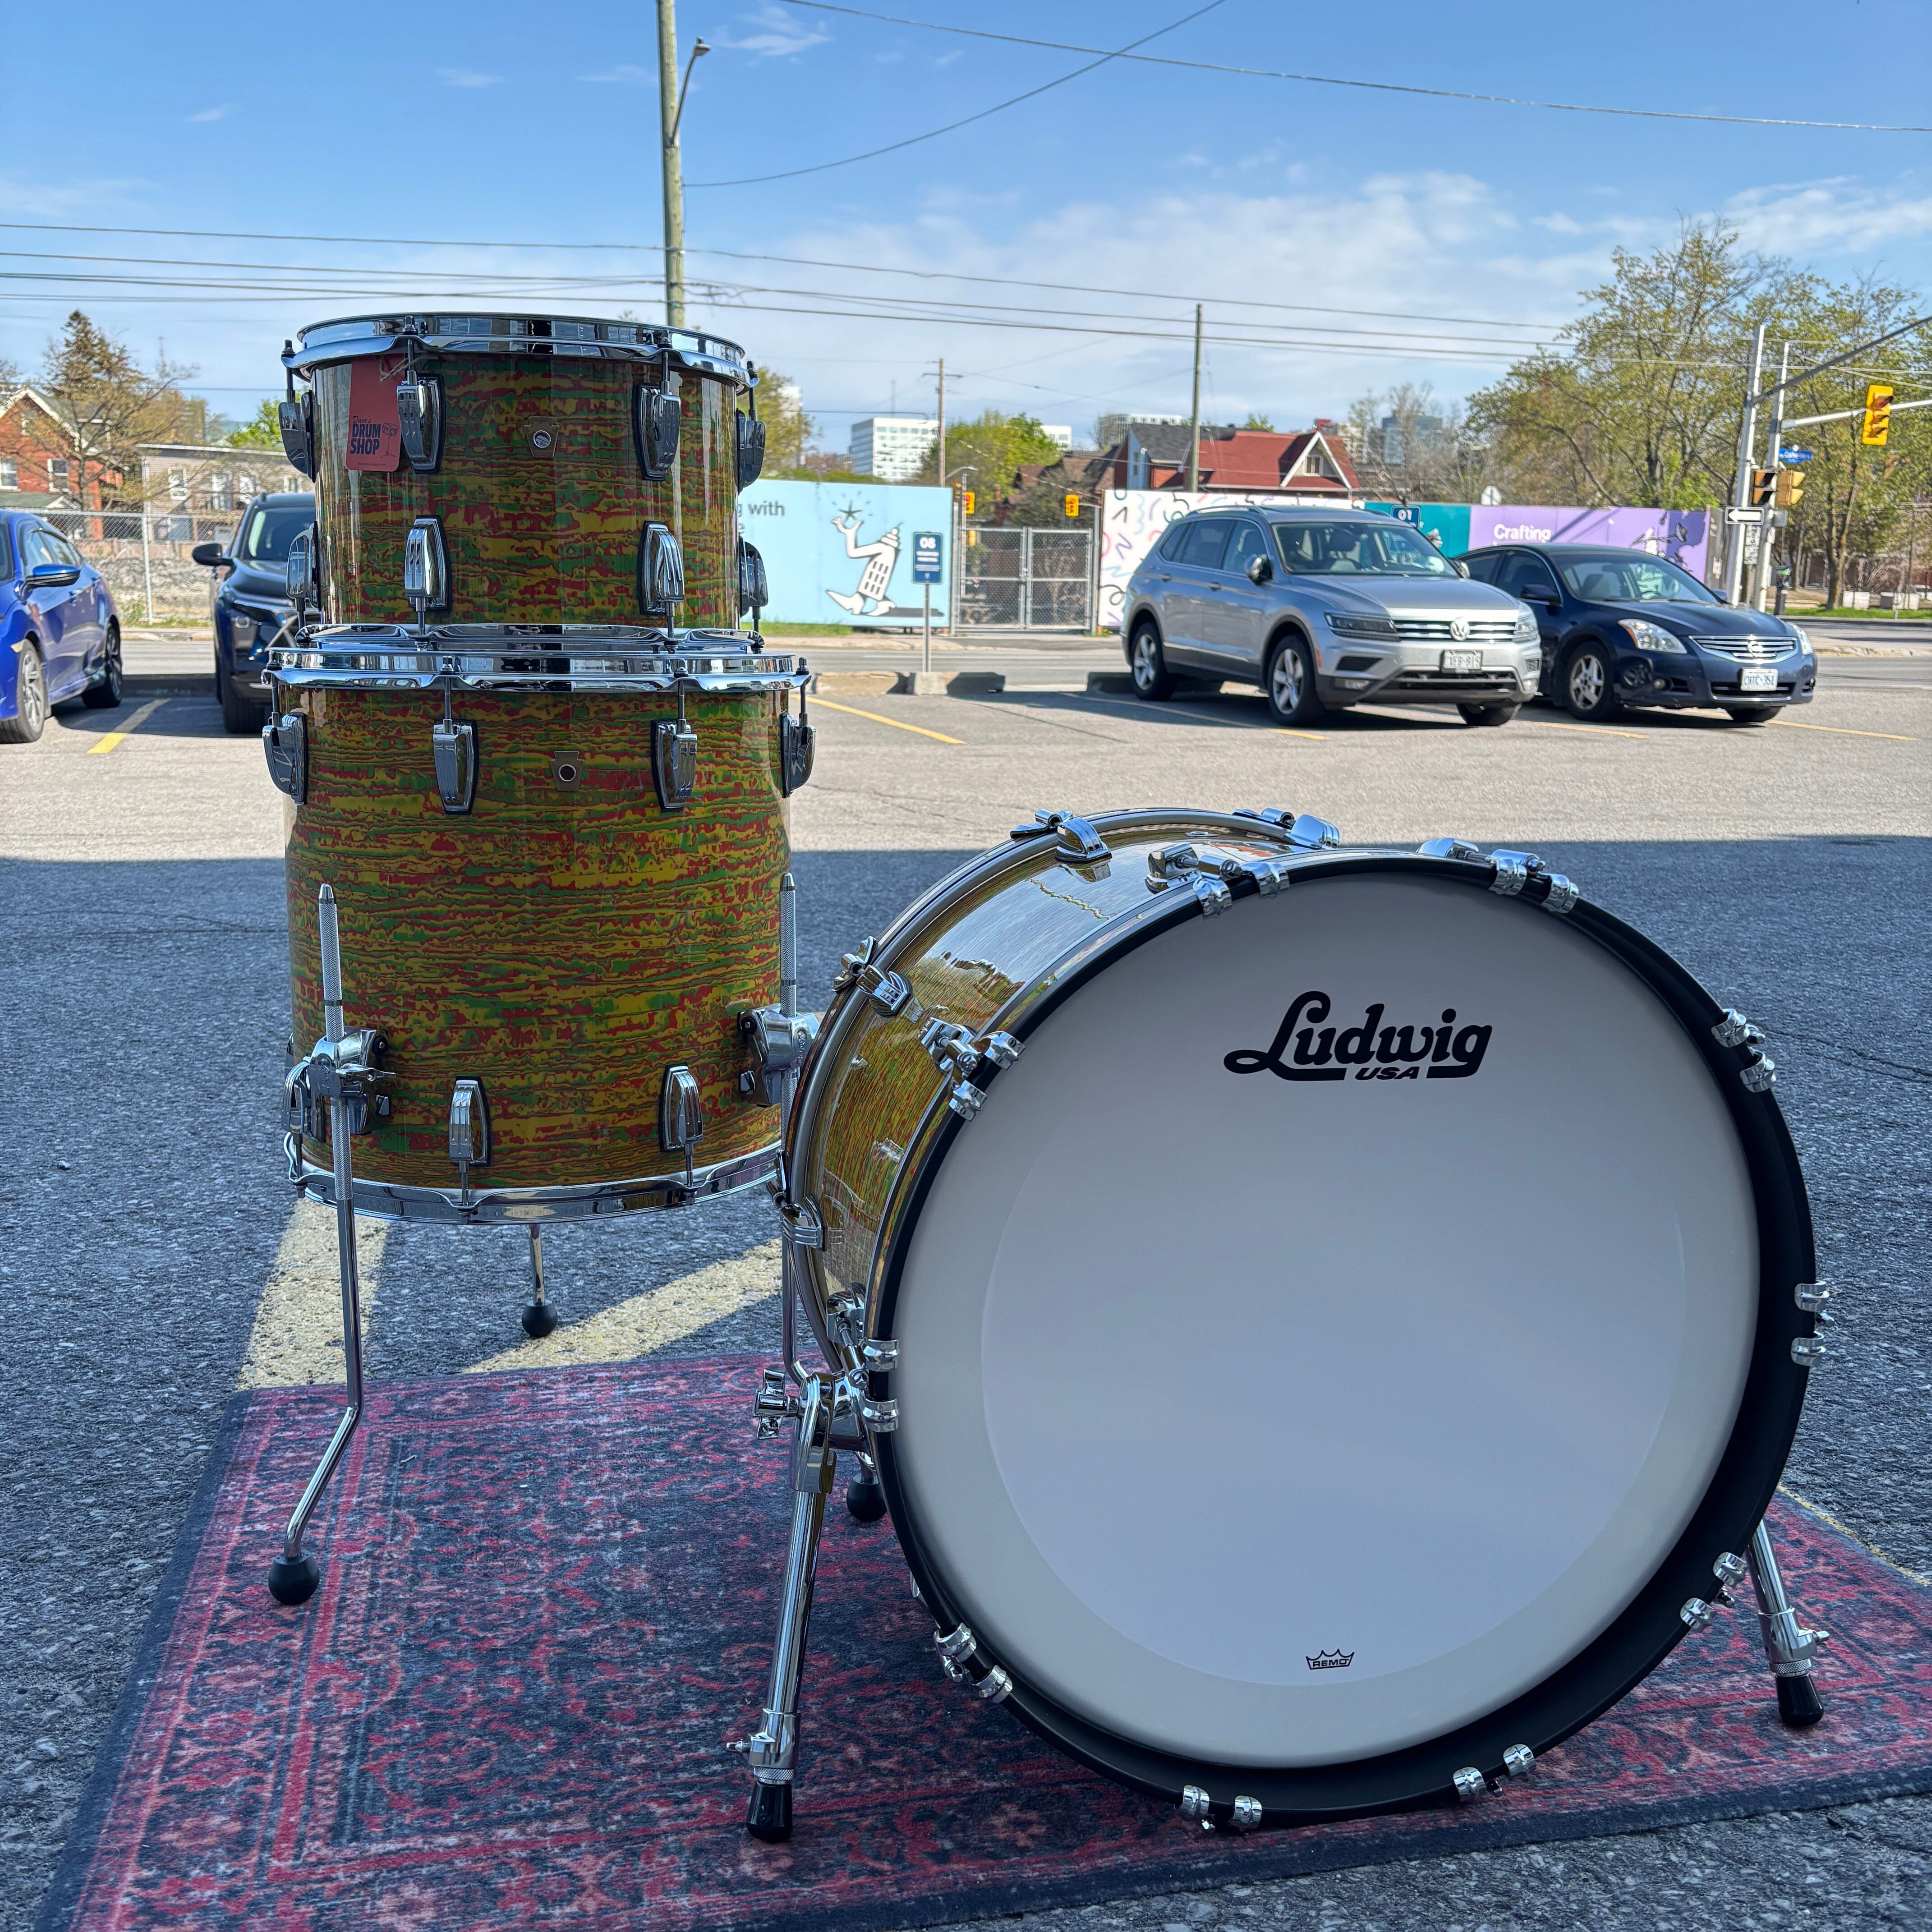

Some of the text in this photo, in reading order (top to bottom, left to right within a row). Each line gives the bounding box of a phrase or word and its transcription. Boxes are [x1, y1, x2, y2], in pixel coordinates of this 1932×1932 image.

[352, 423, 381, 438] DRUM
[350, 438, 380, 455] SHOP
[747, 501, 785, 516] with
[1398, 510, 1412, 520] 01
[1494, 524, 1551, 543] Crafting
[1224, 991, 1492, 1081] Ludwig
[1355, 1067, 1418, 1080] USA
[1313, 1659, 1347, 1667] REMO
